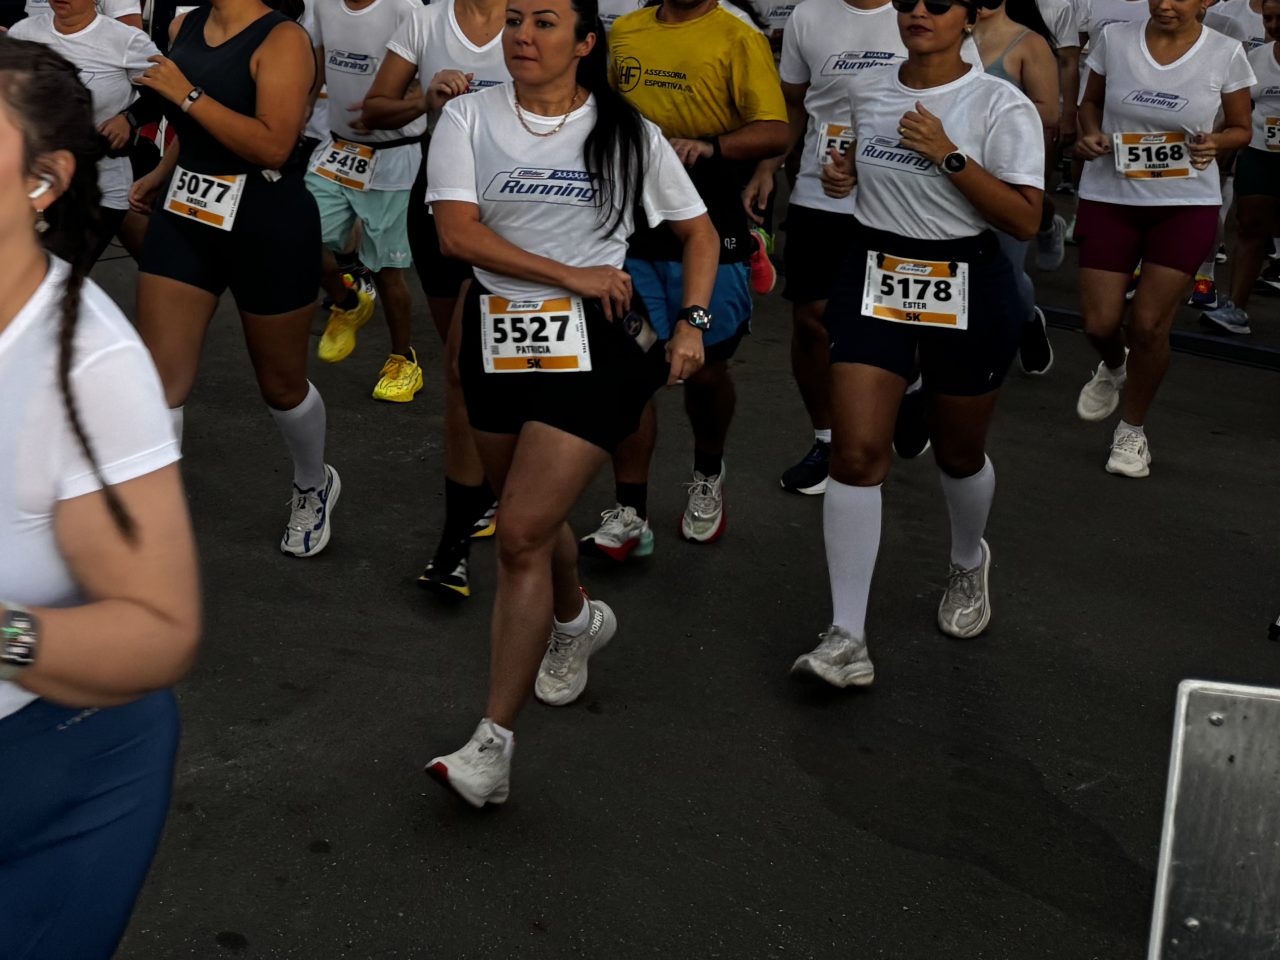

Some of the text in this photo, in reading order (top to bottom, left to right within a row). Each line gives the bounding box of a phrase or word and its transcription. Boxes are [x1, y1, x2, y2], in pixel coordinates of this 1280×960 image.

[328, 55, 369, 72] Running
[644, 68, 687, 80] ASSESSORIA
[644, 79, 683, 90] ESPORTIVA
[1131, 94, 1178, 109] Running
[862, 145, 933, 171] Running
[1128, 144, 1184, 162] 5168
[326, 150, 368, 174] 5418
[176, 171, 231, 204] 5077
[499, 179, 599, 202] Running
[880, 273, 952, 302] 5178
[903, 301, 927, 309] ESTER
[905, 312, 921, 322] 5K
[492, 315, 570, 344] 5527
[515, 345, 551, 354] PATRICIA
[527, 358, 543, 369] 5K
